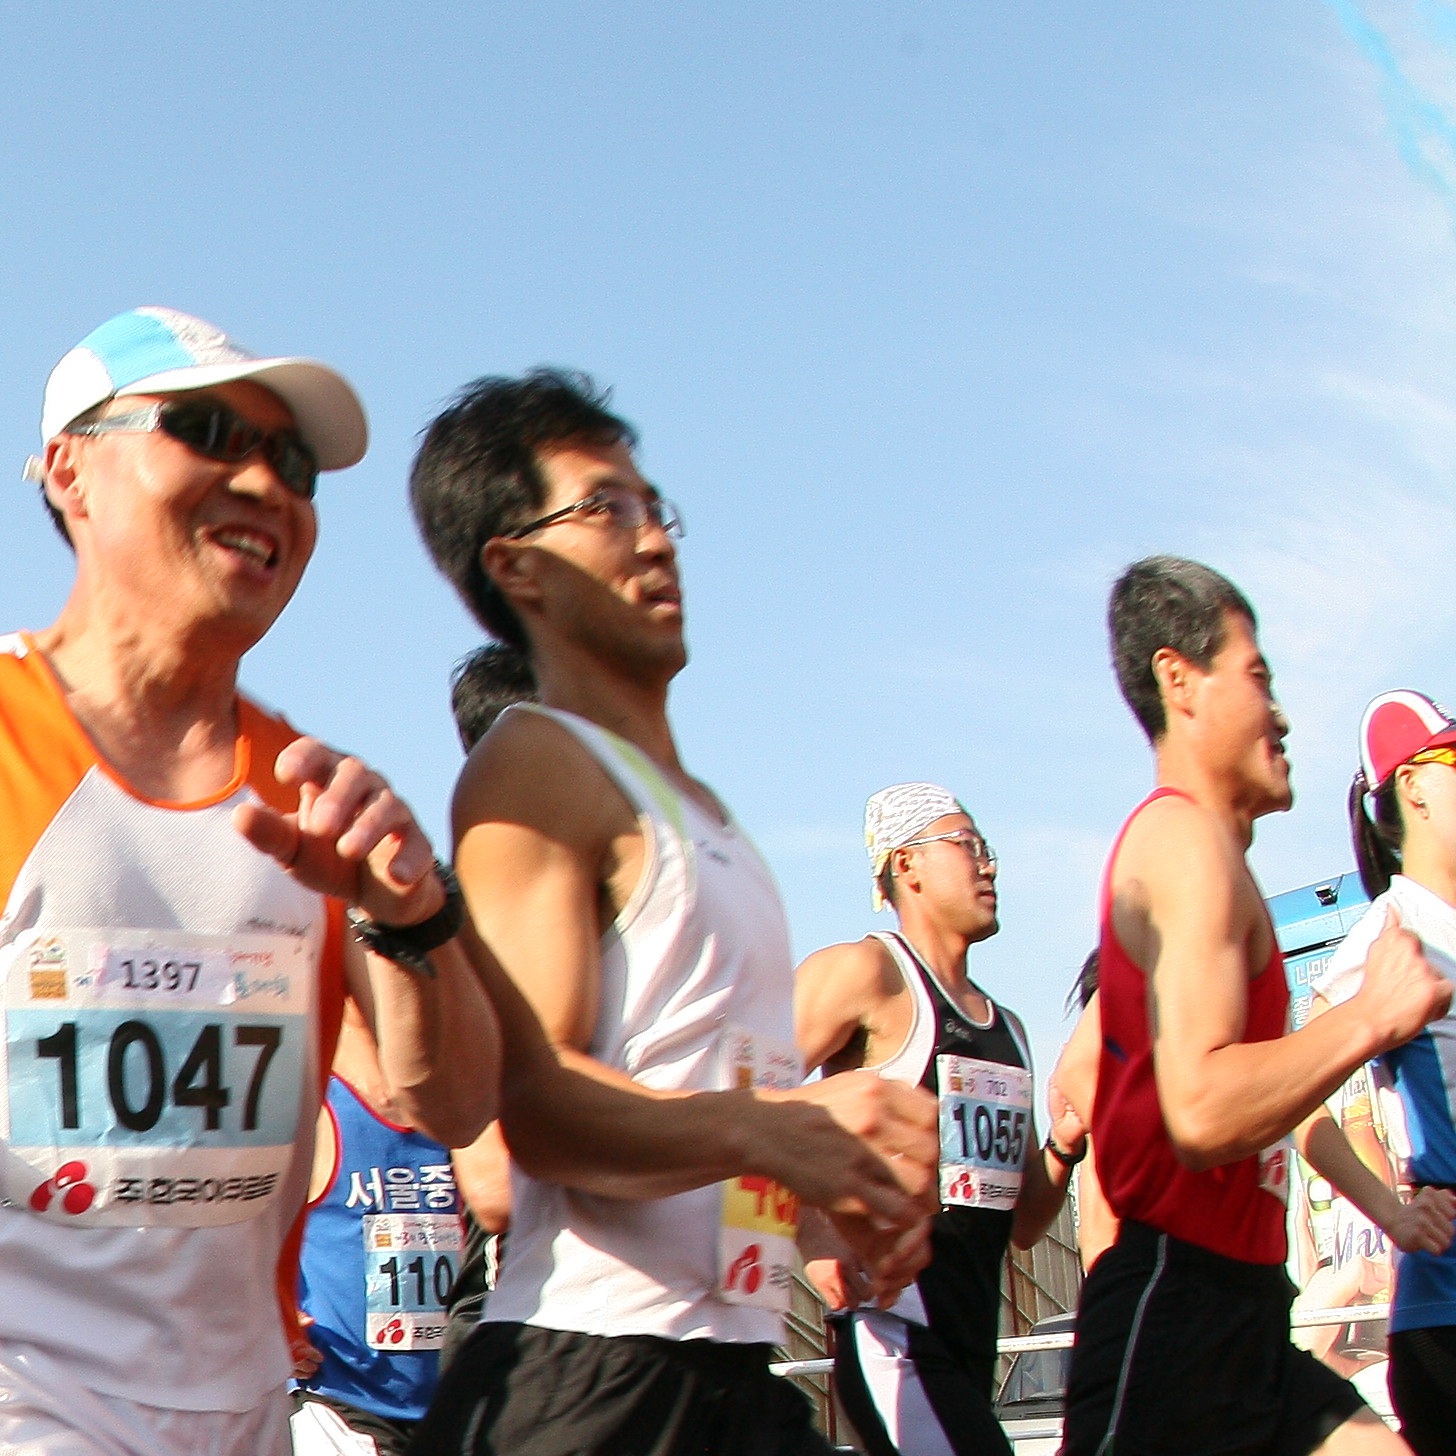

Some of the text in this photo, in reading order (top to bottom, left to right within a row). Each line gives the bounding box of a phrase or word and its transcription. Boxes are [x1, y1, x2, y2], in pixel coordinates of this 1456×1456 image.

[120, 959, 203, 991] 1397
[37, 1021, 283, 1131] 1047
[953, 1103, 1027, 1165] 1055
